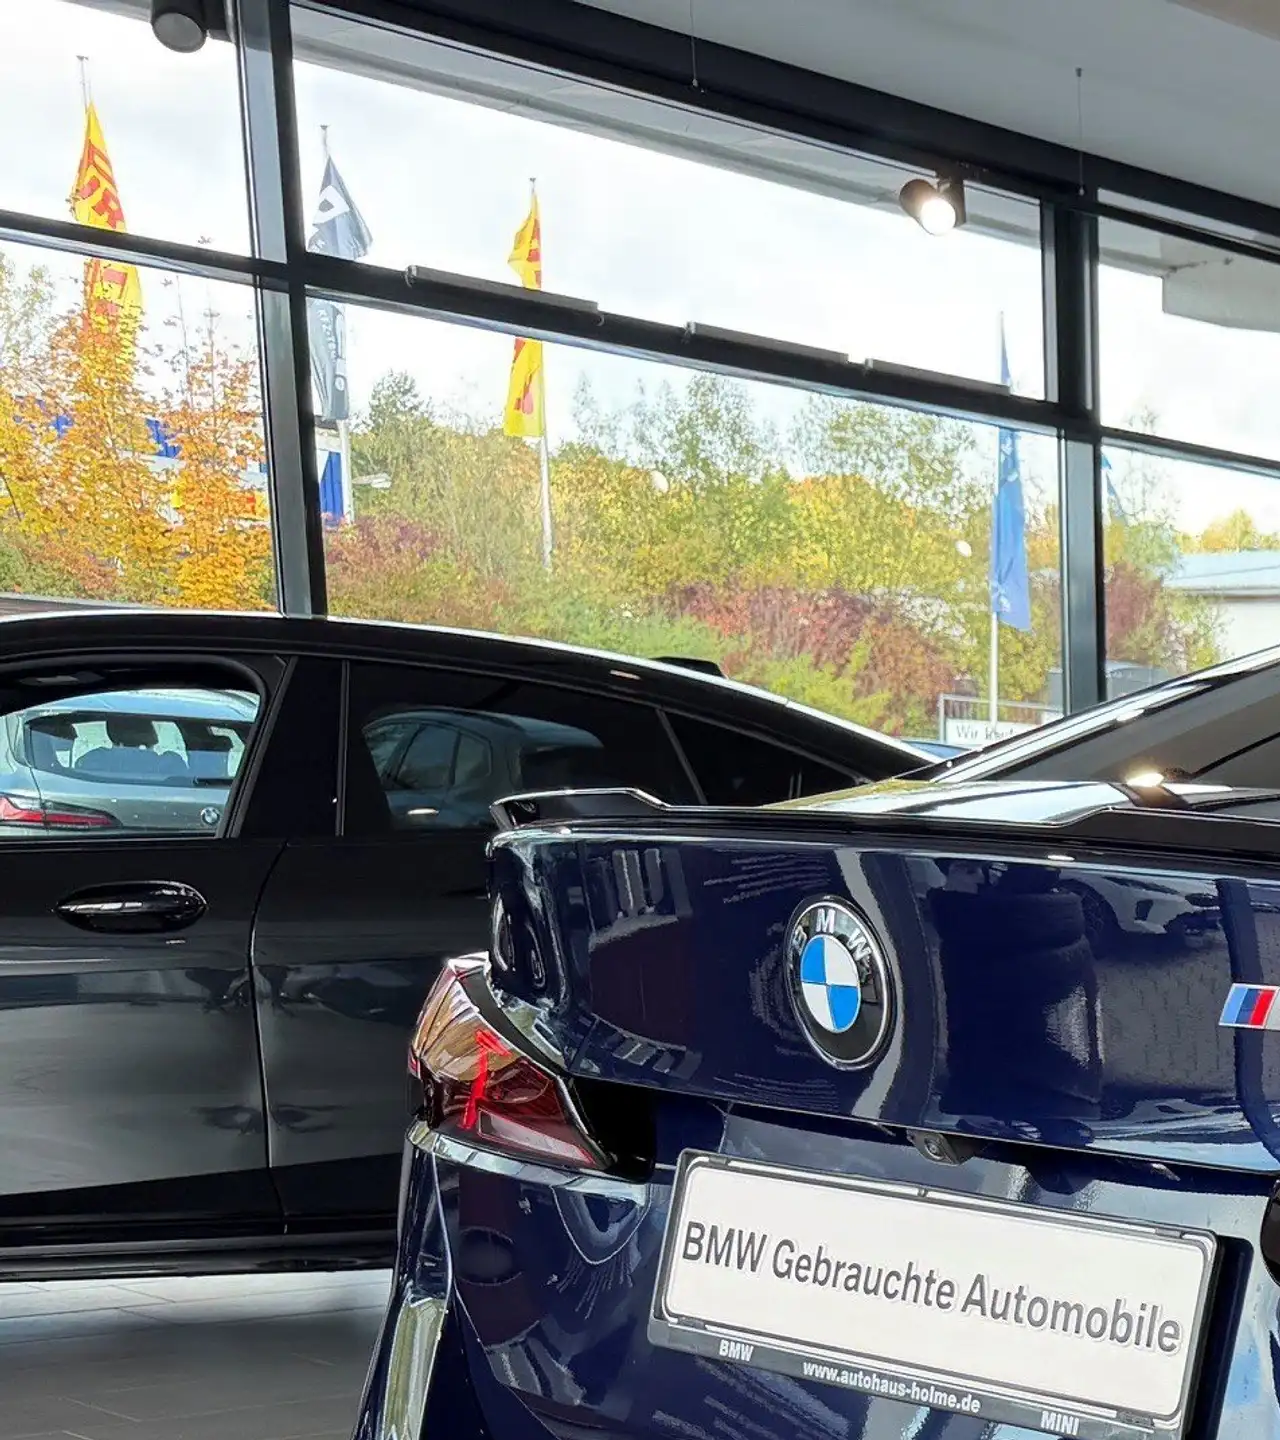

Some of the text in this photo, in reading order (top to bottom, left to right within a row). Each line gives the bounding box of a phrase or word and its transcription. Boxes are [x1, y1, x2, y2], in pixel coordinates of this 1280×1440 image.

[792, 908, 871, 961] BMW
[682, 1220, 1181, 1352] BMW Gebrauchte Automobile
[719, 1339, 1080, 1436] BMW www.autohaus-holme.de MINI
